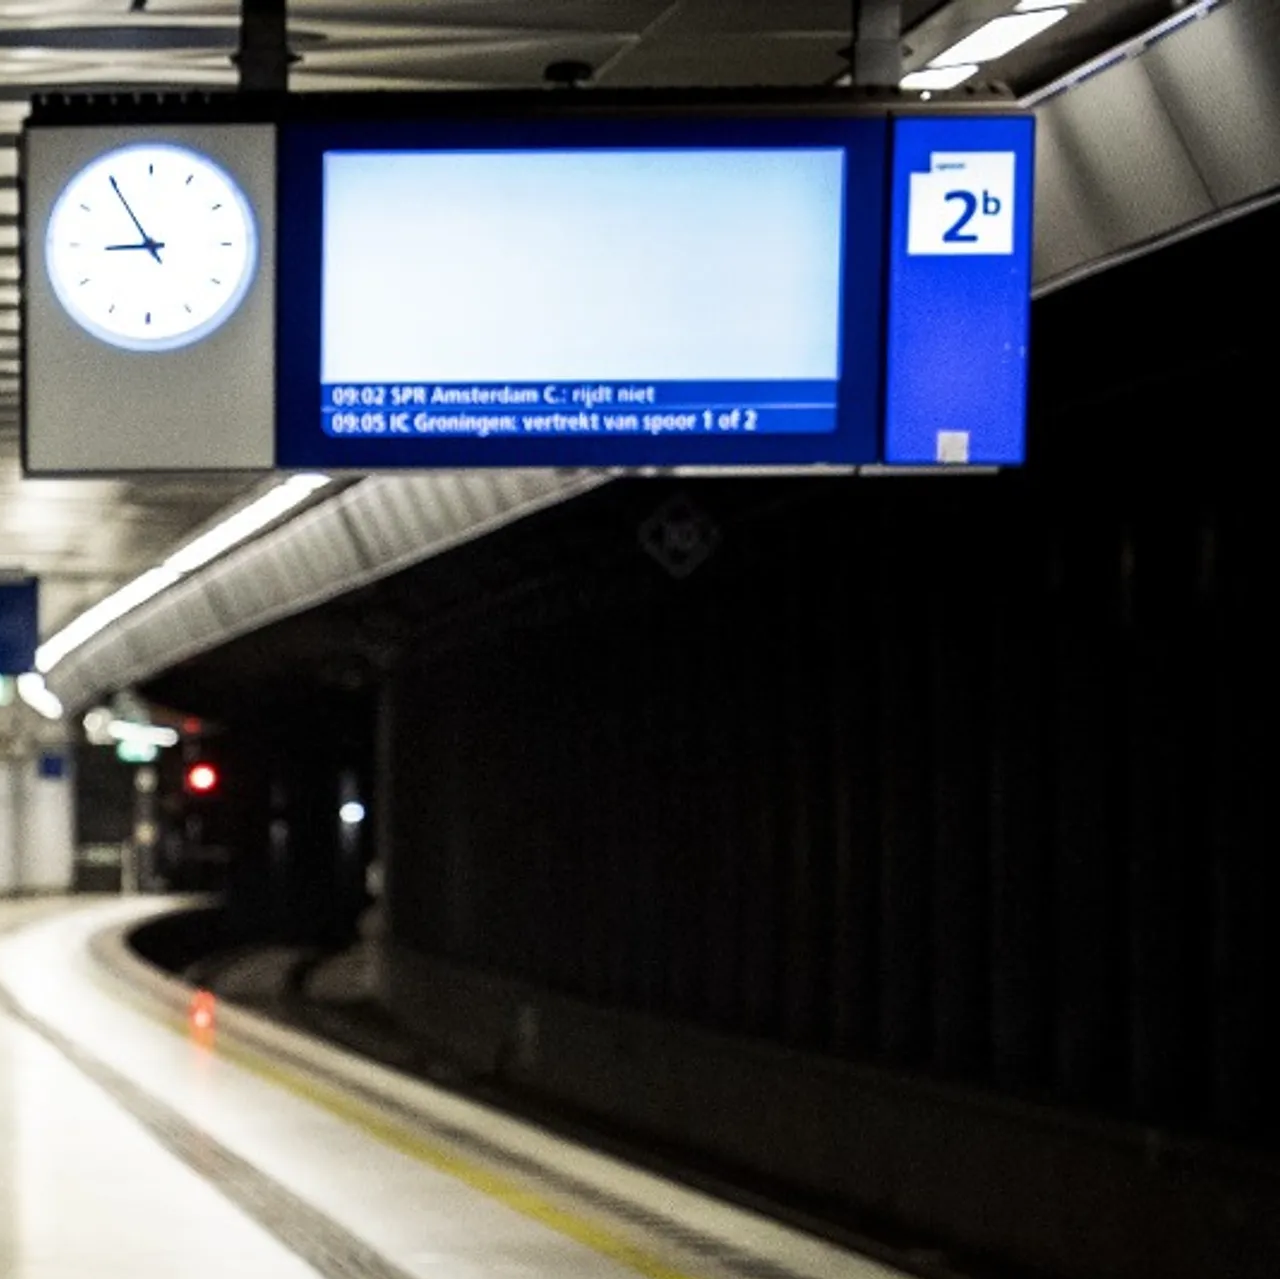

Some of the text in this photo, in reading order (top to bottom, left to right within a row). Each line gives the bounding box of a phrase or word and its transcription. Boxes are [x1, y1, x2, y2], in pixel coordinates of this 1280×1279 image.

[331, 386, 384, 406] 09:02
[390, 386, 426, 405] SPR
[431, 385, 538, 405] Amsterdam
[572, 384, 613, 409] rijdt
[617, 385, 656, 404] niet
[331, 408, 758, 437] 09:05 IC Groningen: vertrekt van spoor 1 of 2
